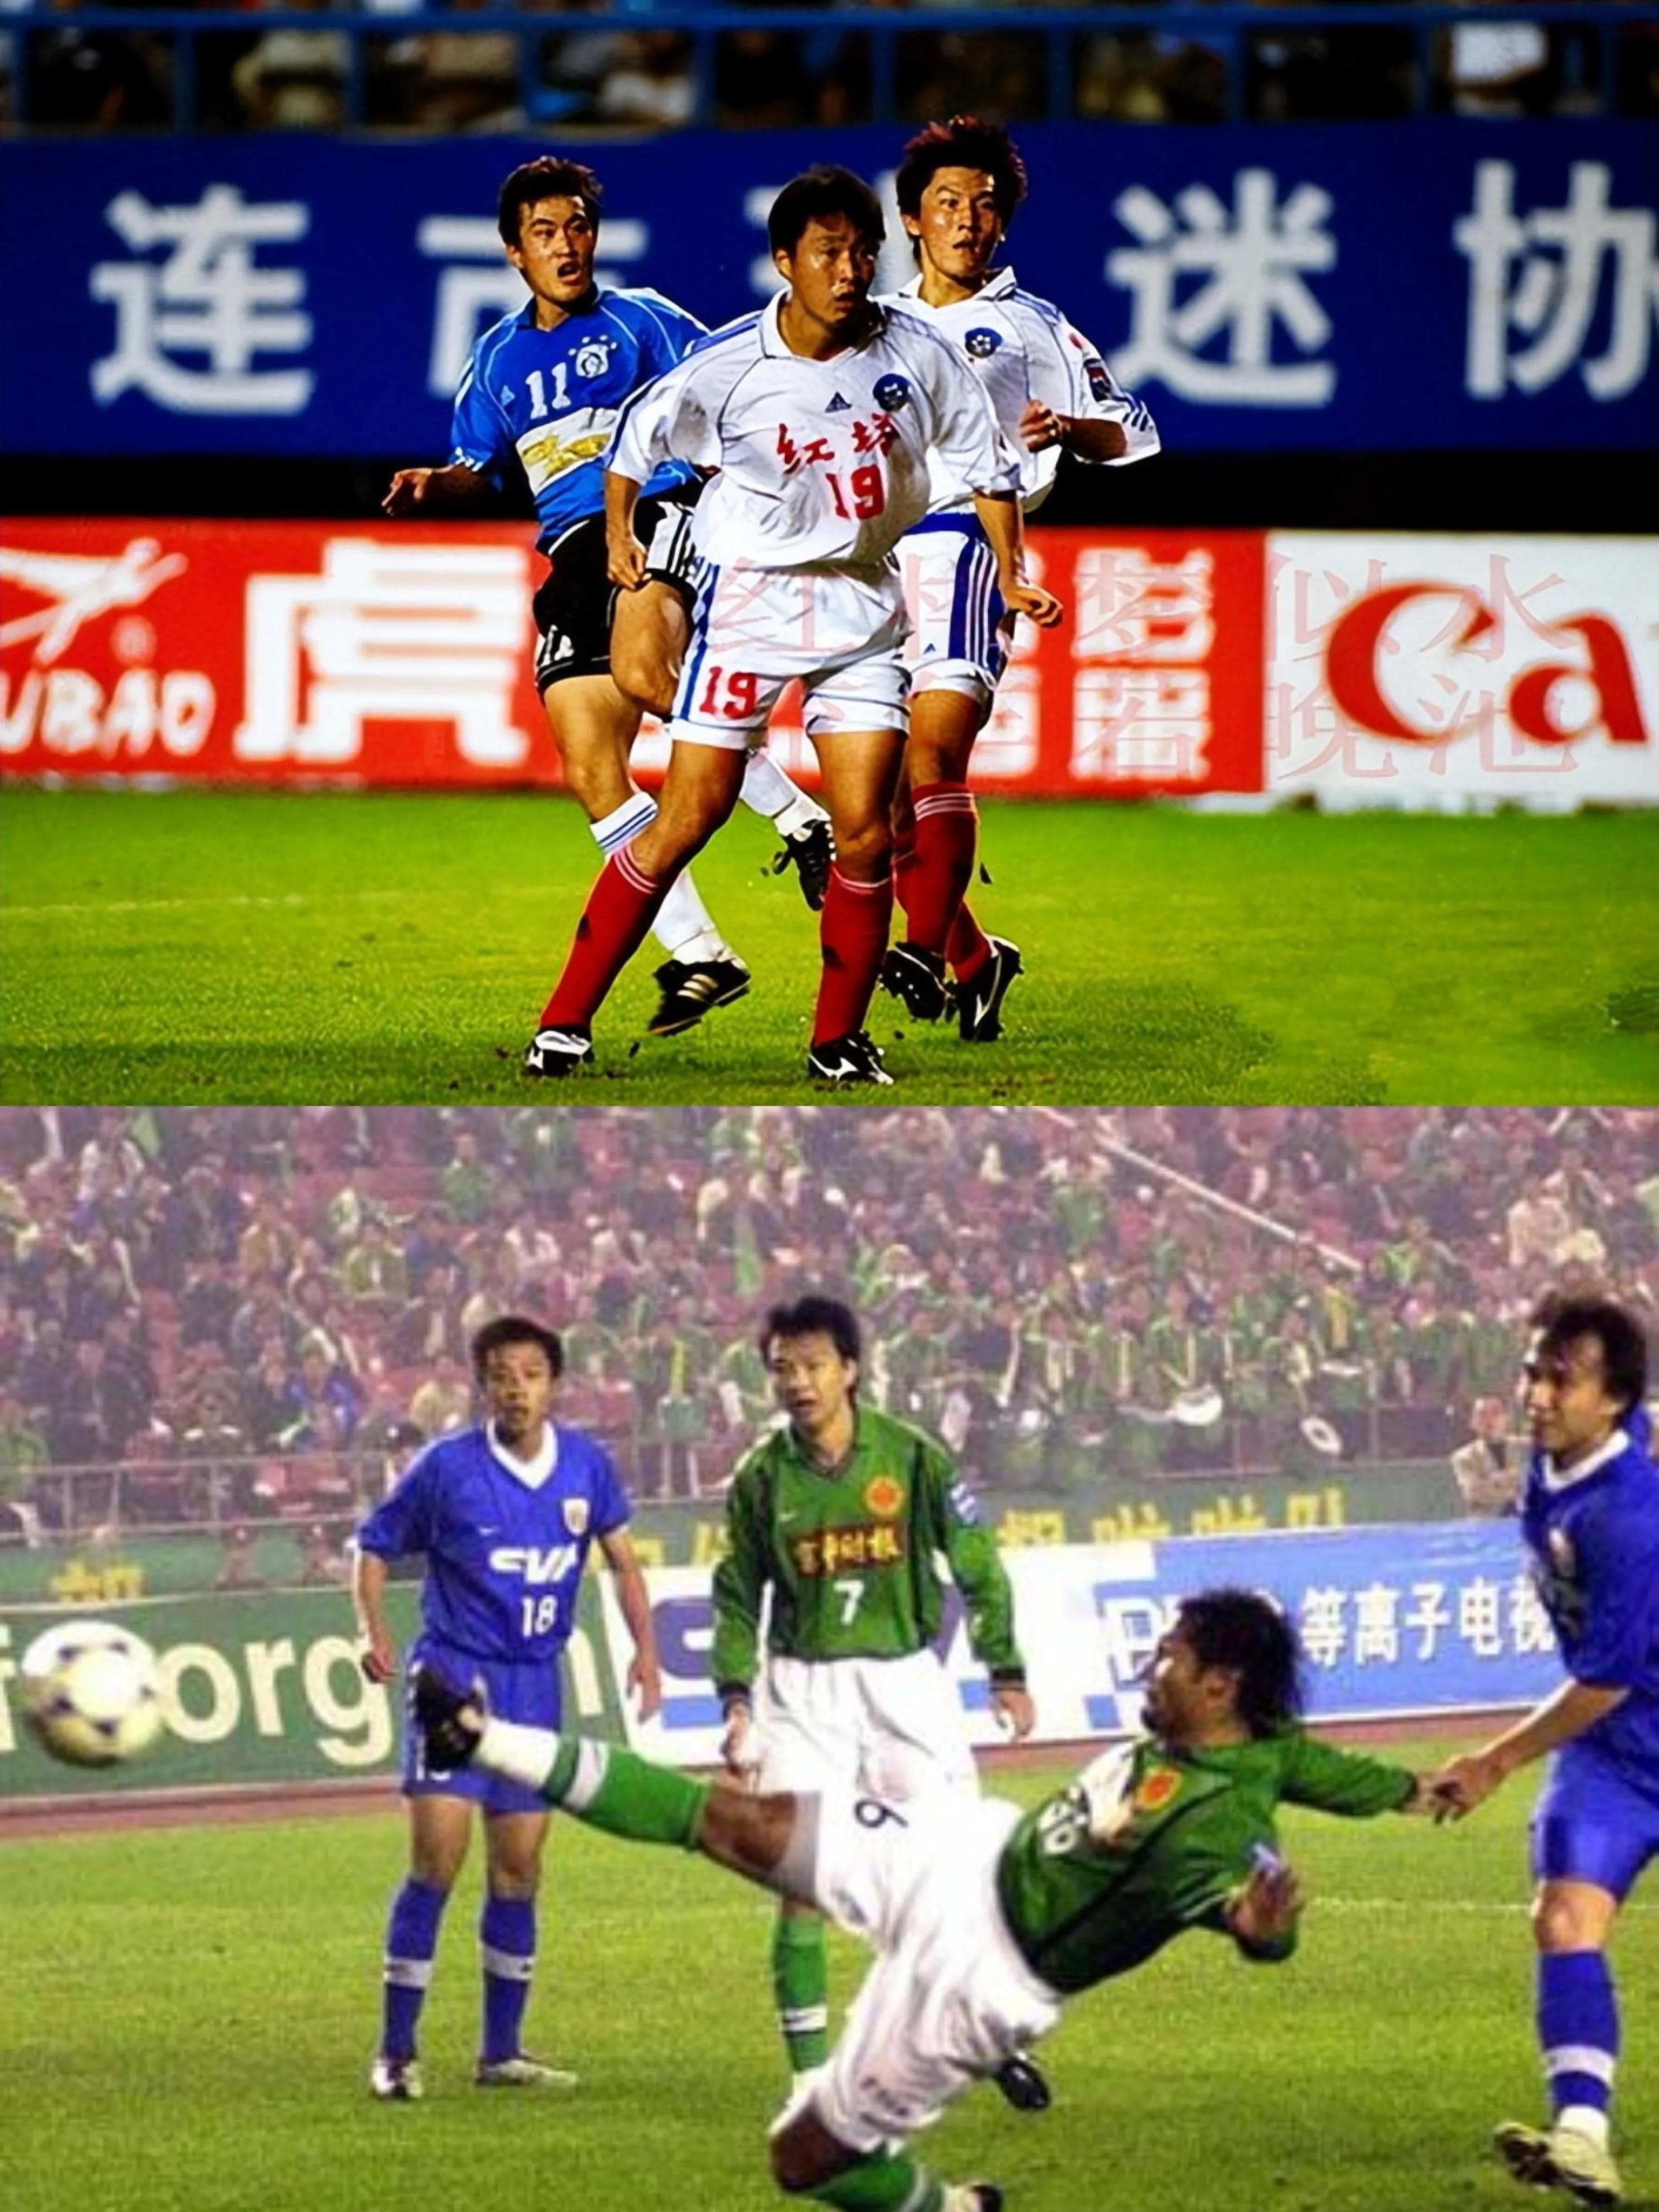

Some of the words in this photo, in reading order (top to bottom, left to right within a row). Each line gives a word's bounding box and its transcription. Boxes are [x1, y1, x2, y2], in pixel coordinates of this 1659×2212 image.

[525, 362, 571, 420] 11
[825, 463, 886, 520] 19
[700, 666, 757, 719] 19
[522, 1595, 558, 1637] 18
[833, 1579, 863, 1626] 7
